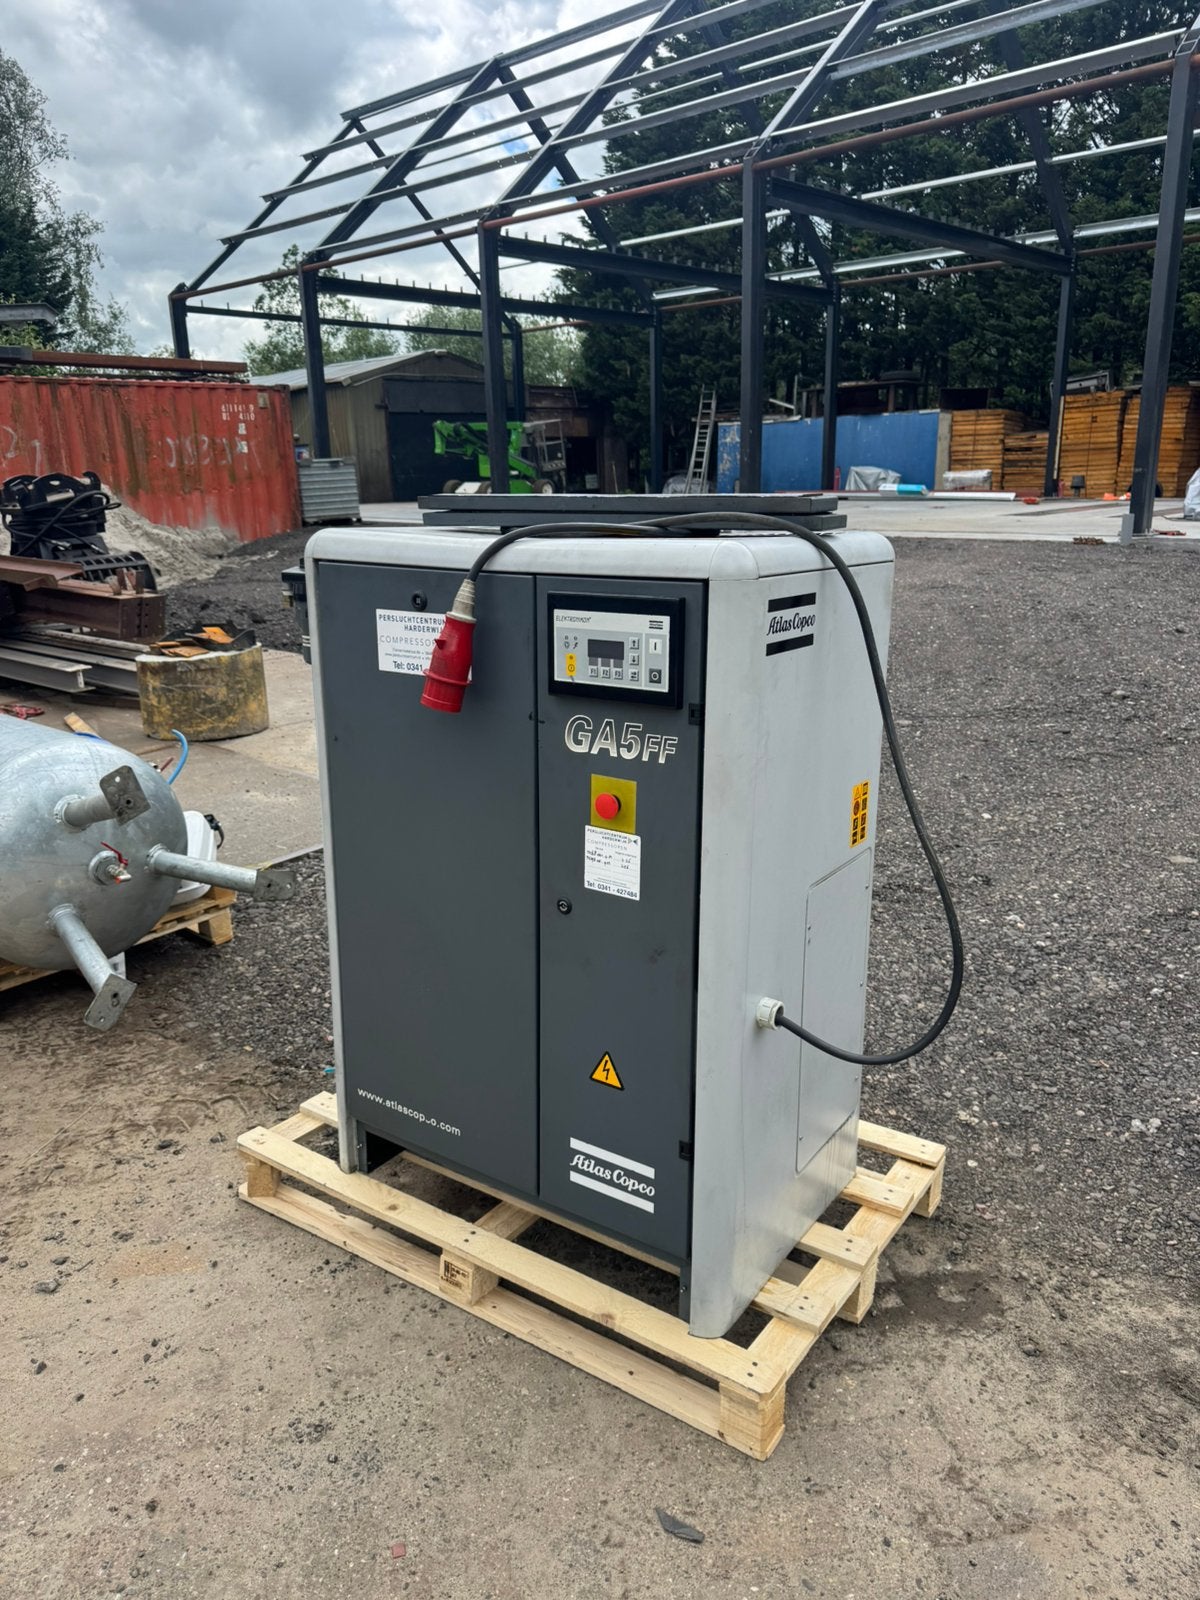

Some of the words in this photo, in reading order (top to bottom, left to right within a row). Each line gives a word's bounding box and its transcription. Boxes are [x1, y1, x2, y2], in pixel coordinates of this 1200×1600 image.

[766, 616, 792, 636] Atlas
[793, 612, 816, 632] Copco
[406, 662, 423, 671] 0341
[590, 667, 597, 675] F1
[602, 669, 609, 677] F2
[597, 883, 611, 891] 0341
[569, 1154, 612, 1180] Atlas
[612, 1169, 655, 1197] Copco
